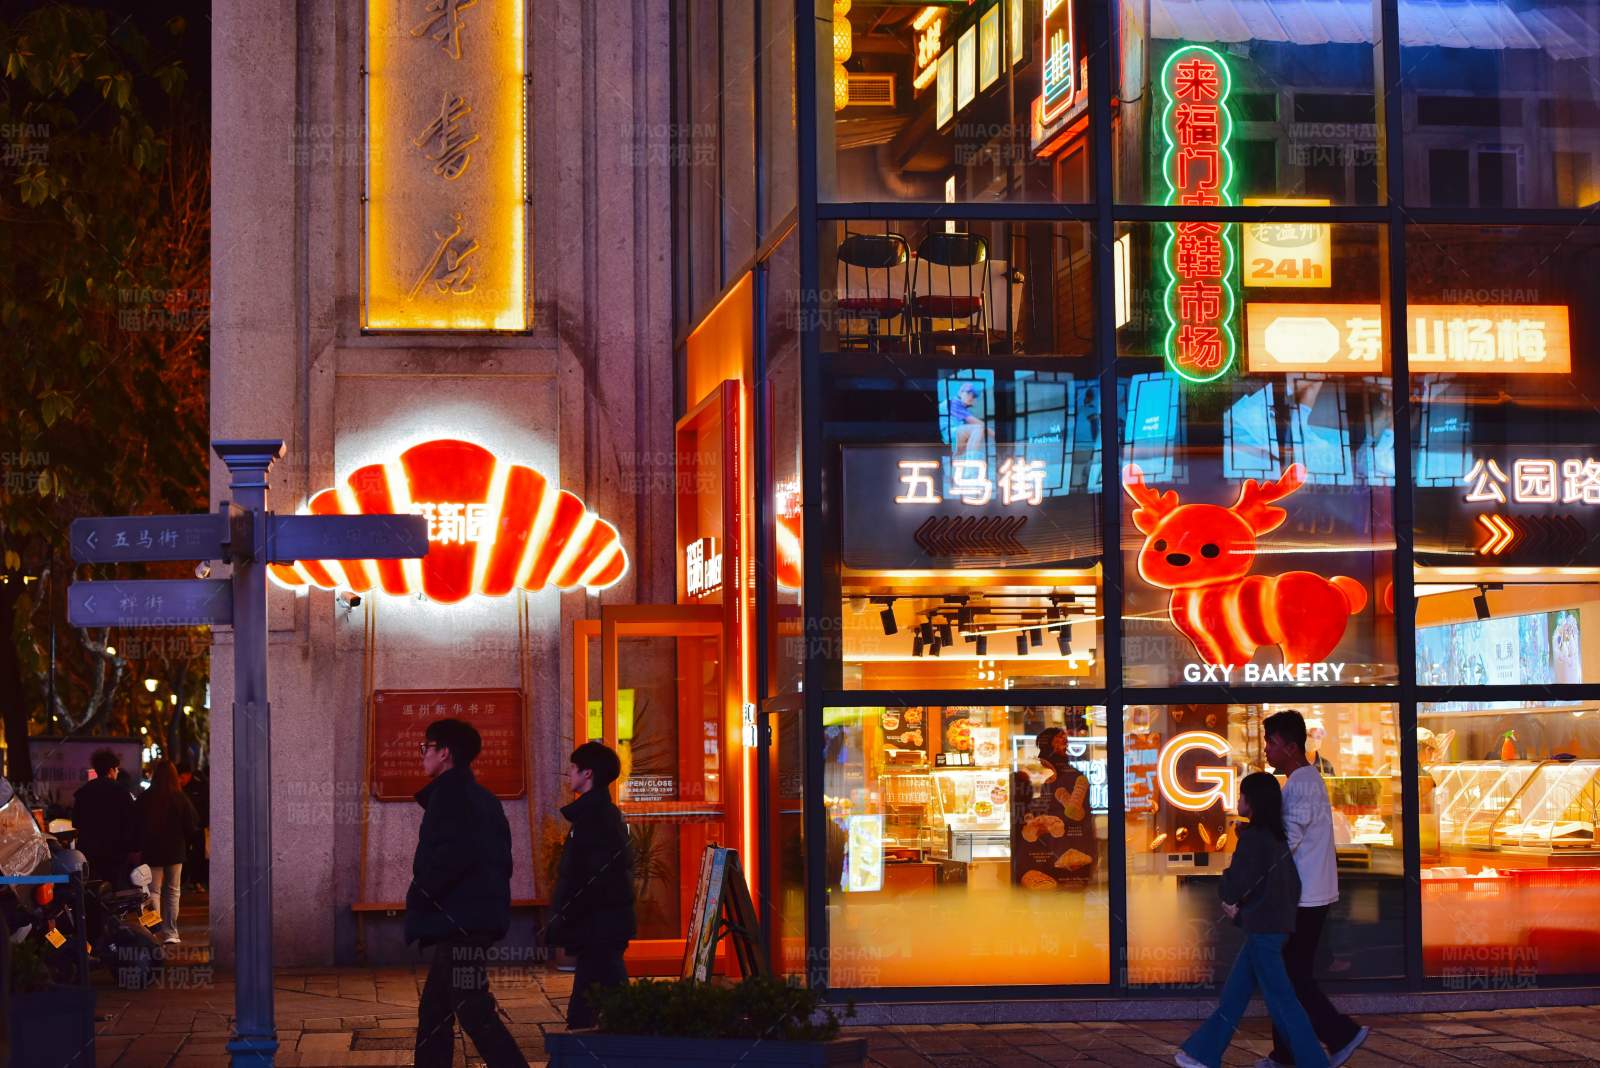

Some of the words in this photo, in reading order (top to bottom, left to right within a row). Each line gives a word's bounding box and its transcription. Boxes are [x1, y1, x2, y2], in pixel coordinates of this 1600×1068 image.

[1175, 59, 1223, 368] 来福门皮鞋市场
[1251, 258, 1323, 279] 24h
[1346, 317, 1547, 362] 东山杨梅
[895, 458, 1047, 506] 五马街
[1464, 458, 1600, 505] 公园路
[1183, 664, 1235, 683] GXY
[1244, 663, 1346, 682] BAKERY
[402, 703, 497, 717] 温州新华书店
[1157, 730, 1238, 813] G
